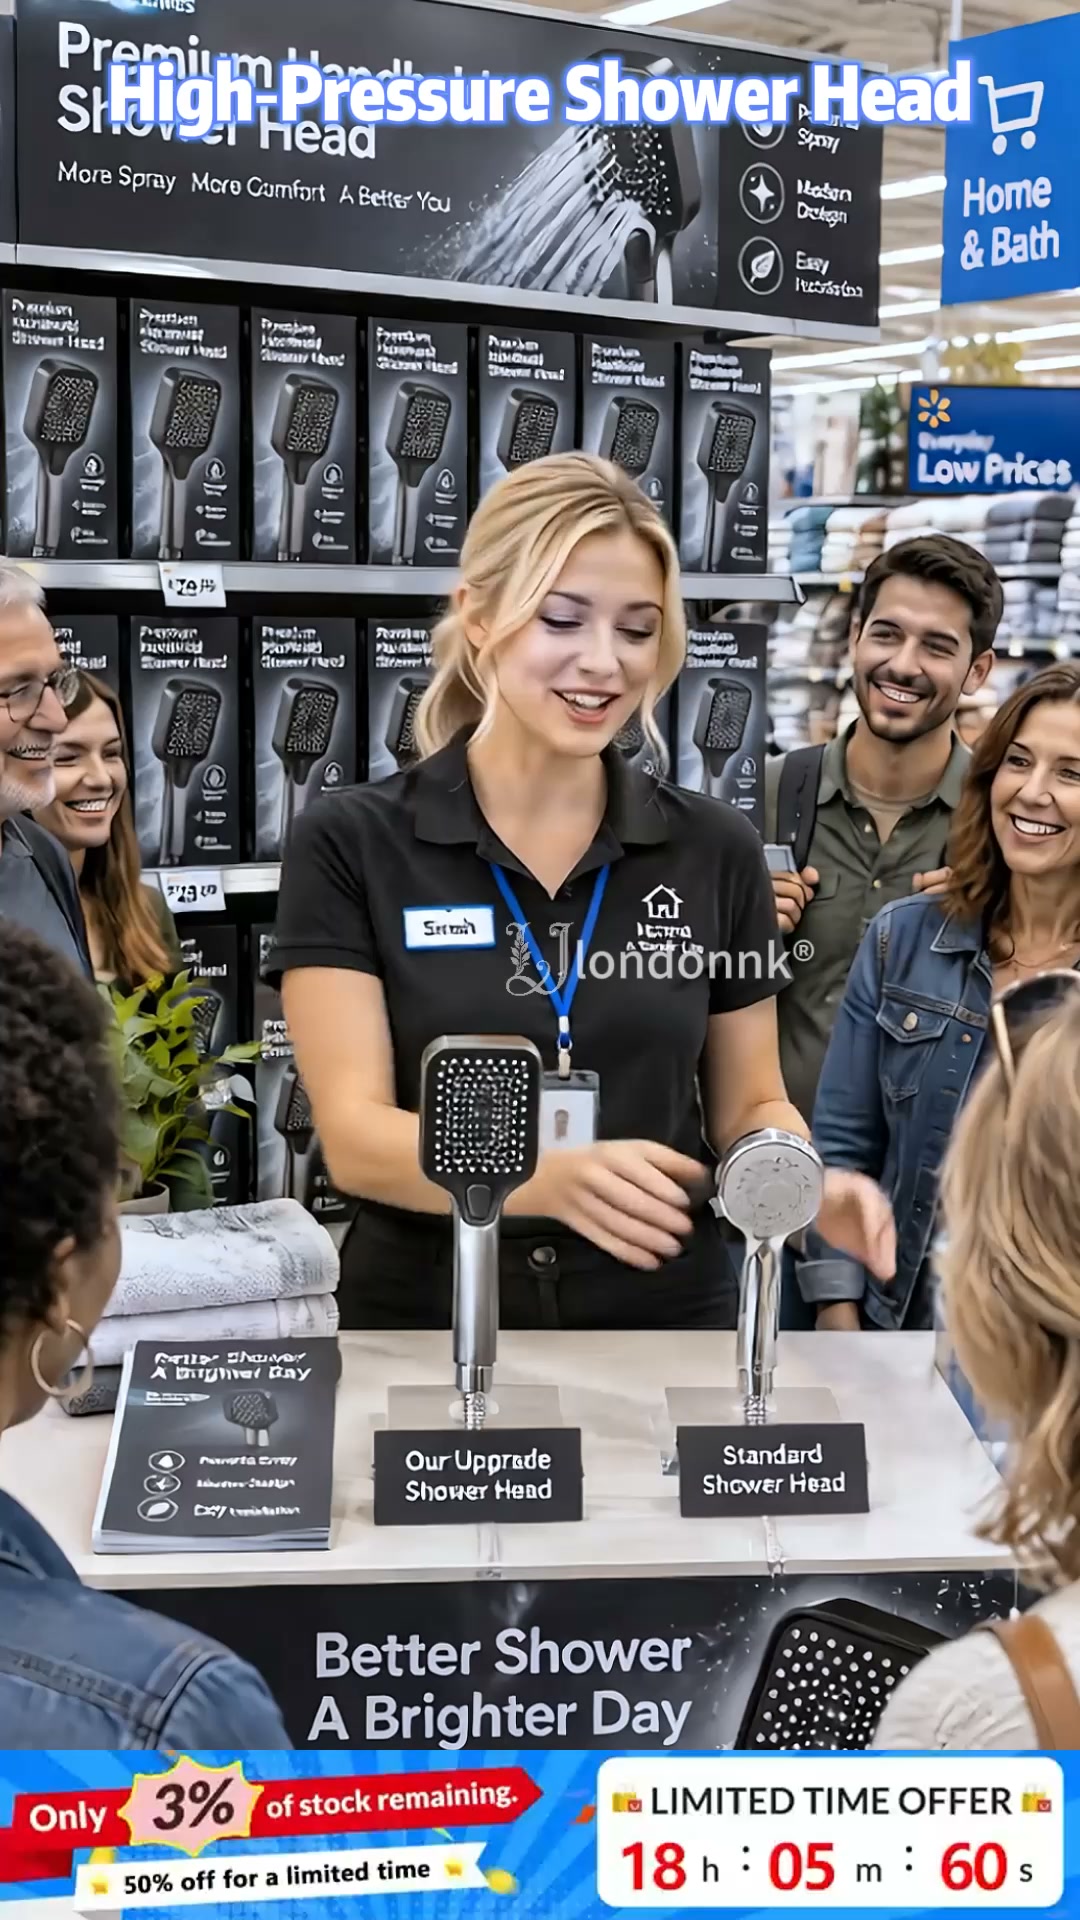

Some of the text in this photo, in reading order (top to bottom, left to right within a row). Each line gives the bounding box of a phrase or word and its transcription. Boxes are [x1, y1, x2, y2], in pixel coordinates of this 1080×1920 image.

[259, 106, 376, 160] Head
[58, 160, 112, 184] More
[118, 165, 177, 195] Spray
[339, 185, 354, 204] A
[416, 191, 451, 212] You
[963, 176, 1053, 218] Home
[960, 222, 1060, 271] & Bath
[917, 452, 1073, 486] Low Prices
[405, 1449, 452, 1472] Our
[723, 1442, 823, 1466] Standard
[405, 1477, 552, 1502] Shower Head
[703, 1471, 846, 1495] Shower Head
[315, 1625, 693, 1680] Better Shower
[307, 1689, 693, 1750] A Brighter Day
